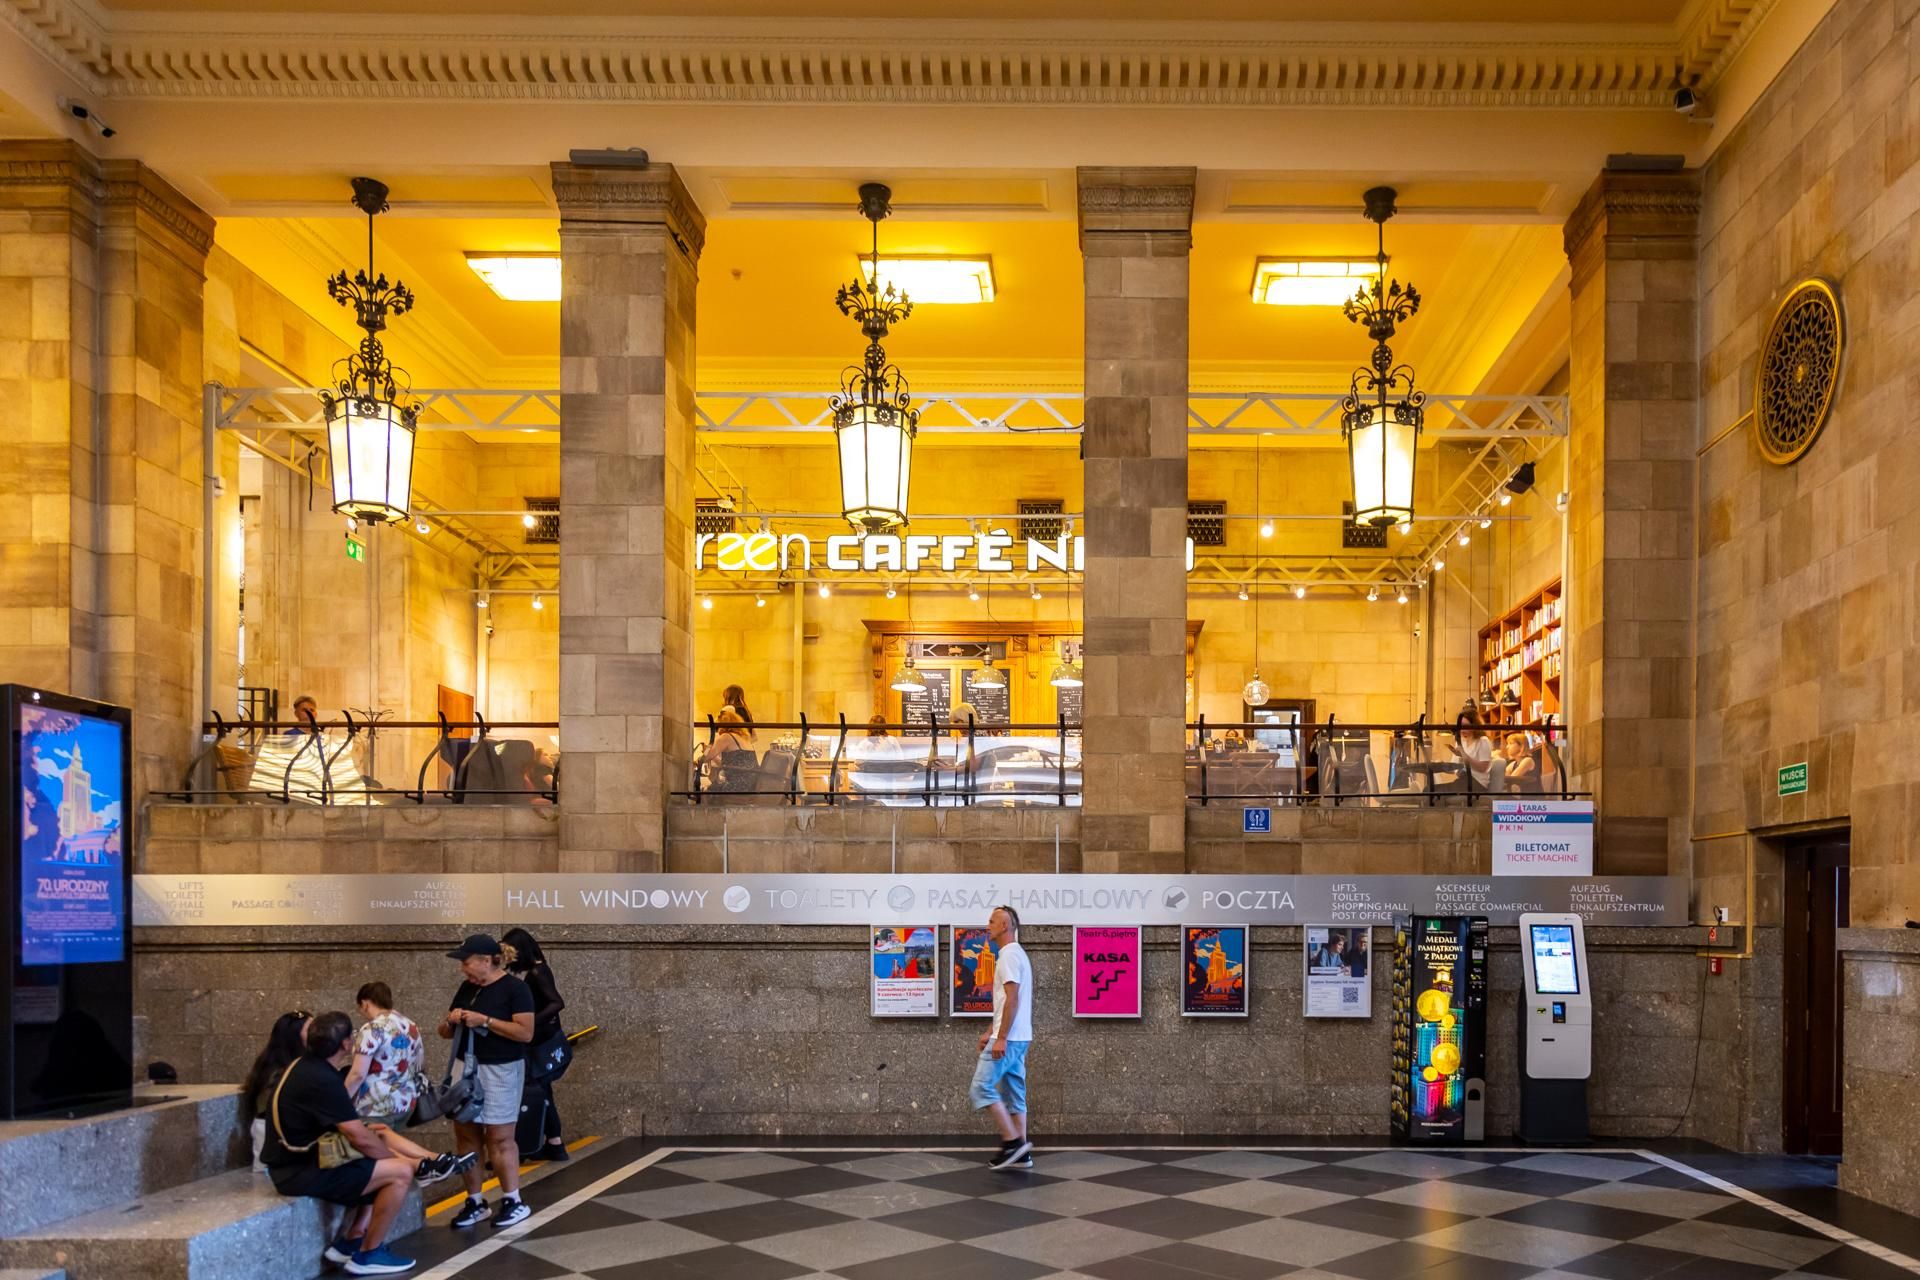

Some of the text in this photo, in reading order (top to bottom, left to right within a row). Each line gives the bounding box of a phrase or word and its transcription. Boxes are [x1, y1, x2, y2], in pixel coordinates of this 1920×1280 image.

[696, 531, 812, 571] reen
[1781, 769, 1805, 782] WYJŚCIE
[1522, 804, 1547, 812] TARAS
[1515, 843, 1571, 852] BILETOMAT
[1506, 854, 1579, 862] TICKET MACHINE
[1331, 883, 1357, 893] LIFTS
[1434, 884, 1491, 893] ASCENSEUR
[1570, 884, 1611, 893] AUFZUG
[506, 889, 709, 909] HALL WINDOWY
[764, 888, 879, 909] TOALETY
[927, 884, 1153, 910] PASAŻ HANDLOWY
[1202, 890, 1295, 911] POCZTA
[1331, 893, 1371, 902] TOILETS
[1434, 893, 1486, 902] TOILETTES
[1570, 893, 1623, 902] TOILETTEN
[1331, 902, 1409, 911] SHOPPING HALL
[1434, 902, 1544, 911] PASSAGE COMMERCIAL
[1570, 902, 1665, 911] EINKAUFSZENTRUM
[1331, 911, 1393, 920] POST OFFICE
[1577, 912, 1594, 921] OST
[1425, 935, 1458, 944] MEDALE
[1417, 945, 1464, 953] PAMIĄTKOWE
[1083, 952, 1130, 963] KASA
